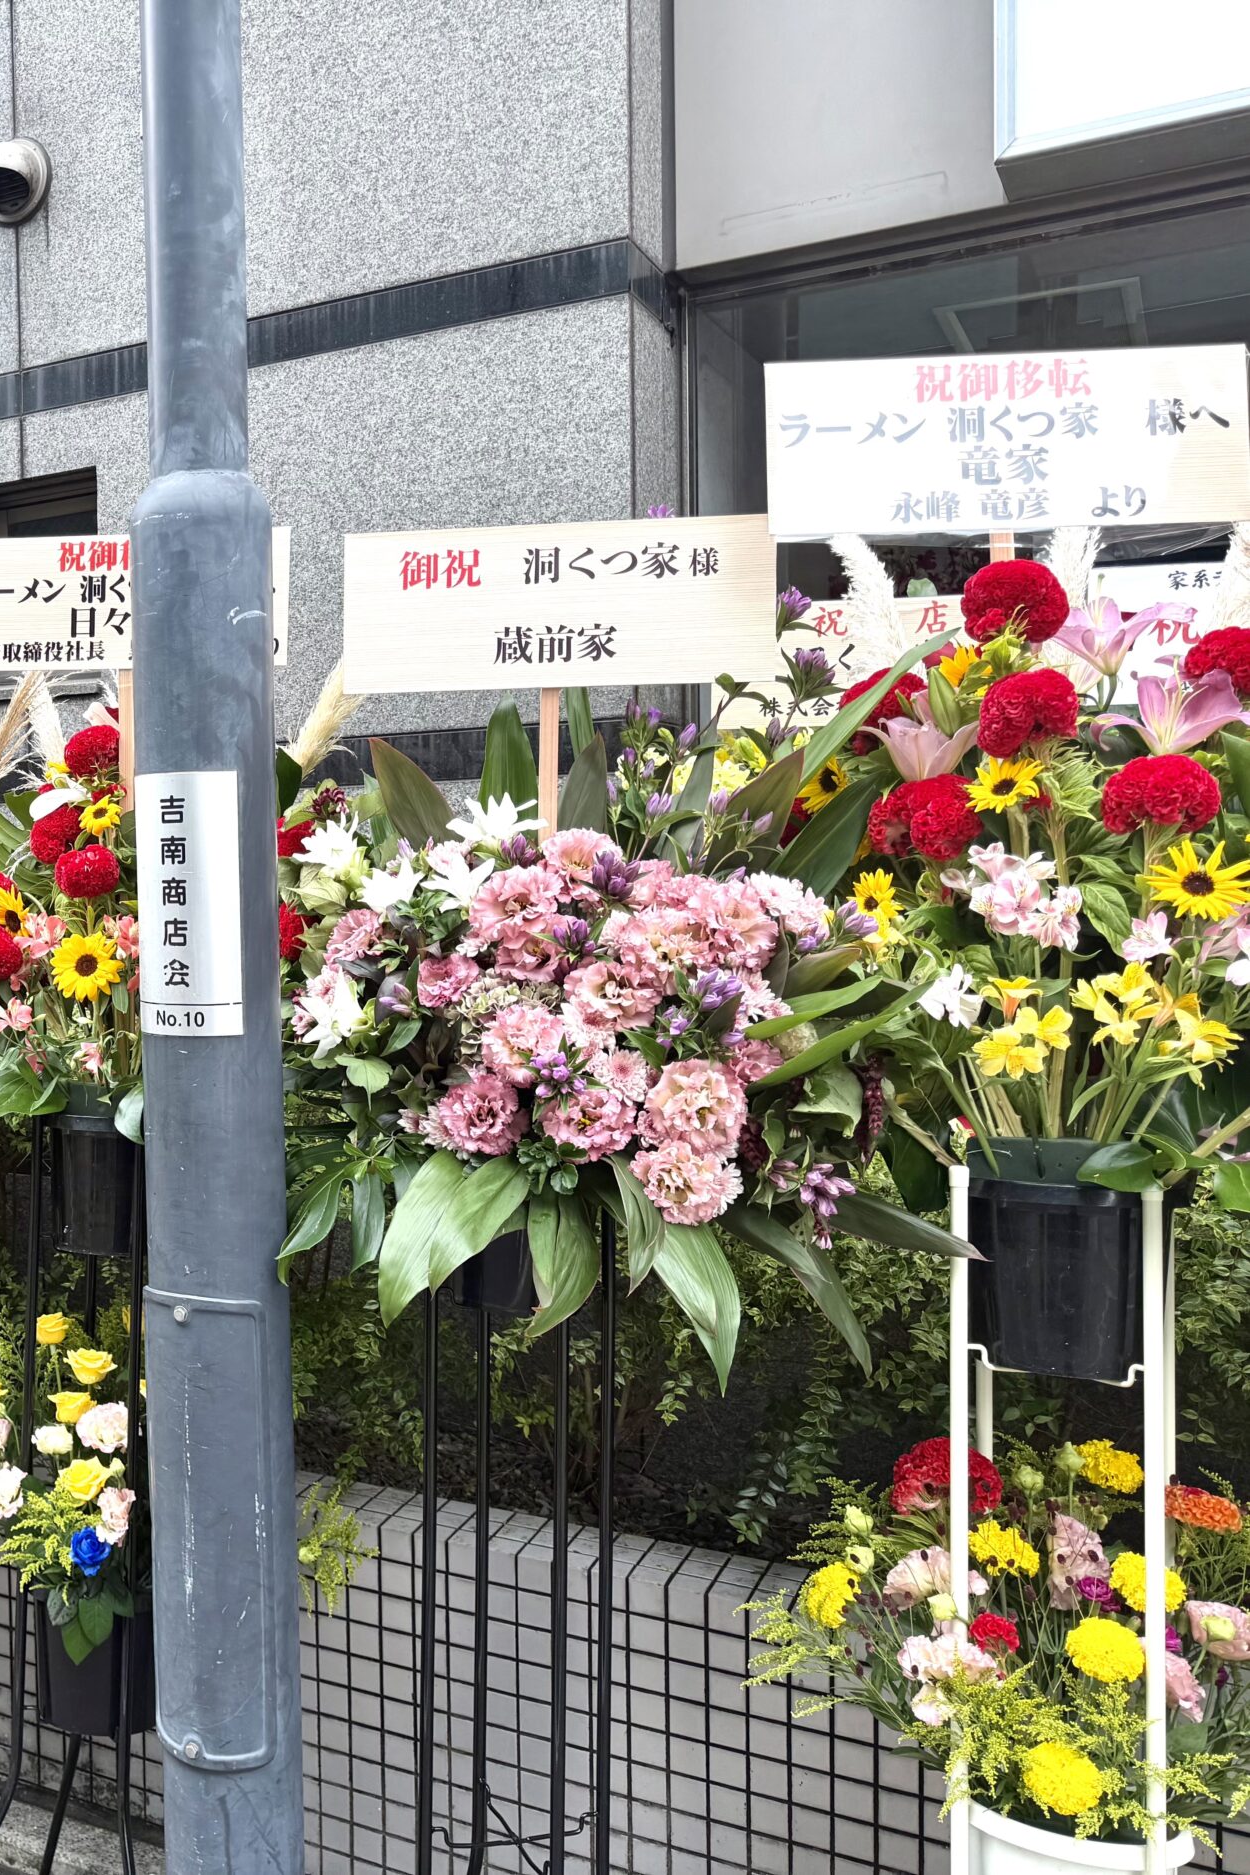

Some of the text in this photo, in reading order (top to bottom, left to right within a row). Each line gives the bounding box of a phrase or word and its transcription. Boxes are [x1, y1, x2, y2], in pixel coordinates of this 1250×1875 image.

[915, 358, 1092, 404] 祝御移転
[779, 399, 1230, 448] ラーメン 洞くつ家 様へ
[958, 444, 1050, 486] 竜家
[890, 485, 1147, 523] 永峰 竜彦 より
[80, 574, 130, 603] 洞く
[400, 549, 481, 590] 御祝
[493, 623, 617, 665] 蔵前家
[759, 697, 842, 718] 株式会
[160, 795, 190, 988] 吉南商店会
[156, 1009, 205, 1028] No.10
